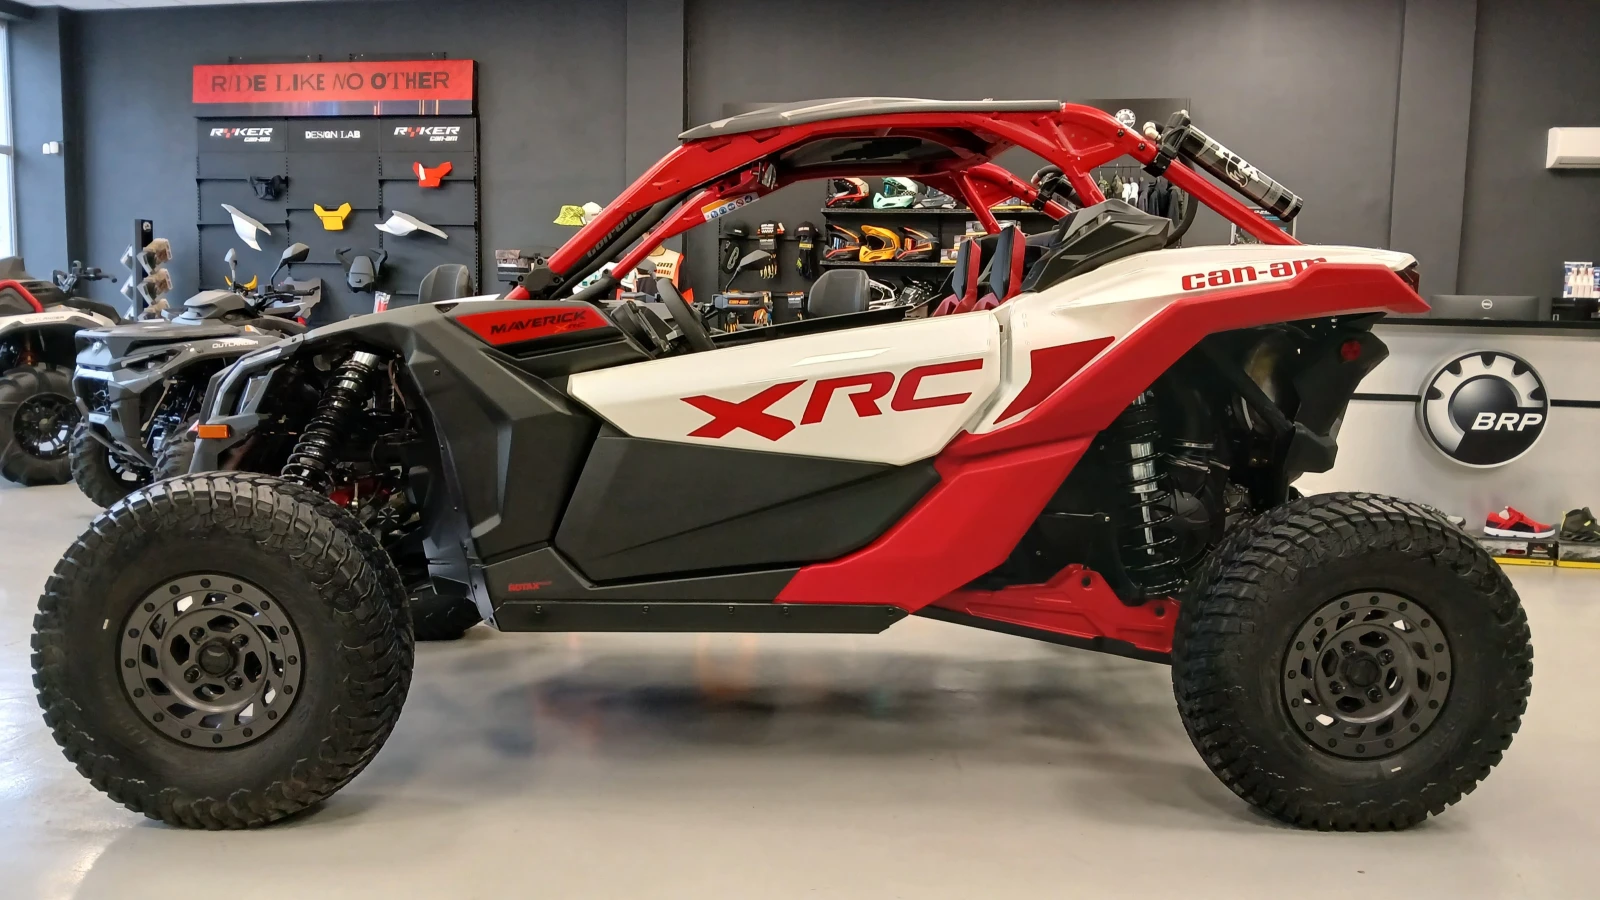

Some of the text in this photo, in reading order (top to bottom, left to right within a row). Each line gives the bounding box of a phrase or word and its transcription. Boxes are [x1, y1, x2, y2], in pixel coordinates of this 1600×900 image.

[211, 71, 450, 92] RIDE LIKE NO OTHER
[305, 130, 361, 139] DESIGN LAB
[490, 310, 586, 335] MAVERICK
[679, 357, 984, 442] XRC
[1471, 412, 1543, 432] BRP
